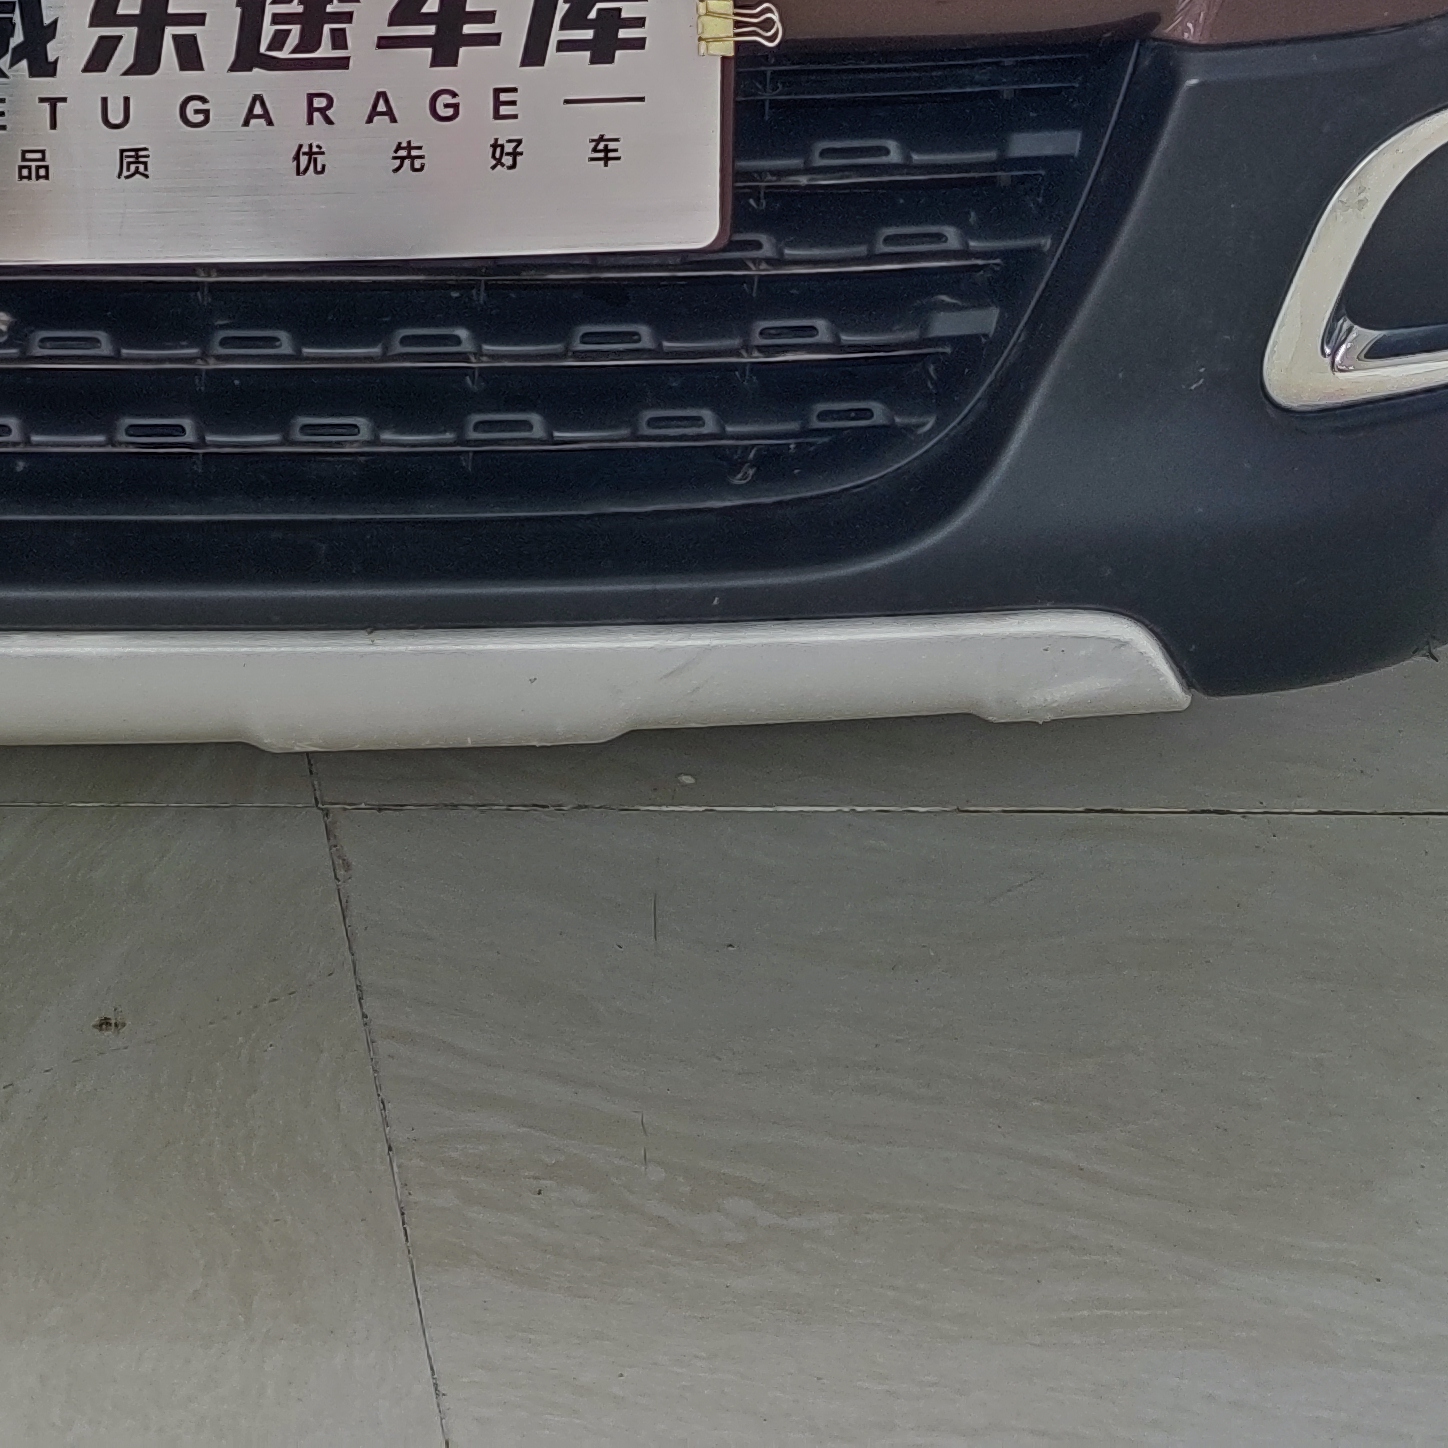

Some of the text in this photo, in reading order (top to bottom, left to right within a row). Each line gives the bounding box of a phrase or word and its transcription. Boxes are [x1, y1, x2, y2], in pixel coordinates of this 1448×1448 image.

[177, 86, 521, 130] GARAGE
[290, 133, 624, 179] 优先好车
